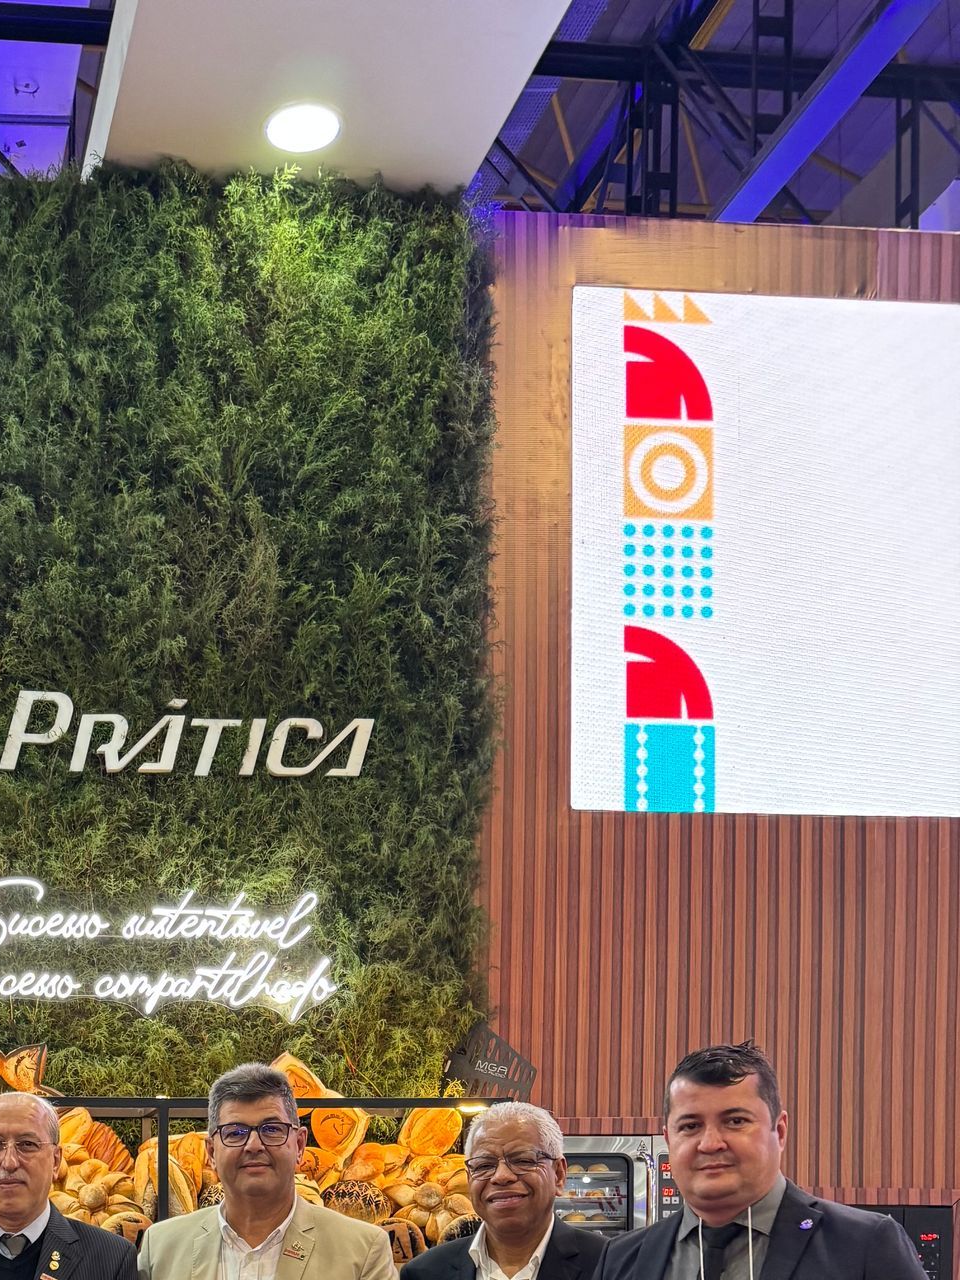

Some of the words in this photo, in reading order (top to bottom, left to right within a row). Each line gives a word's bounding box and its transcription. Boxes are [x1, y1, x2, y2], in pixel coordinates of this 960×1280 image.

[0, 690, 375, 777] PRÁTICA
[94, 951, 337, 1022] compartilhado
[475, 1060, 508, 1075] MGA
